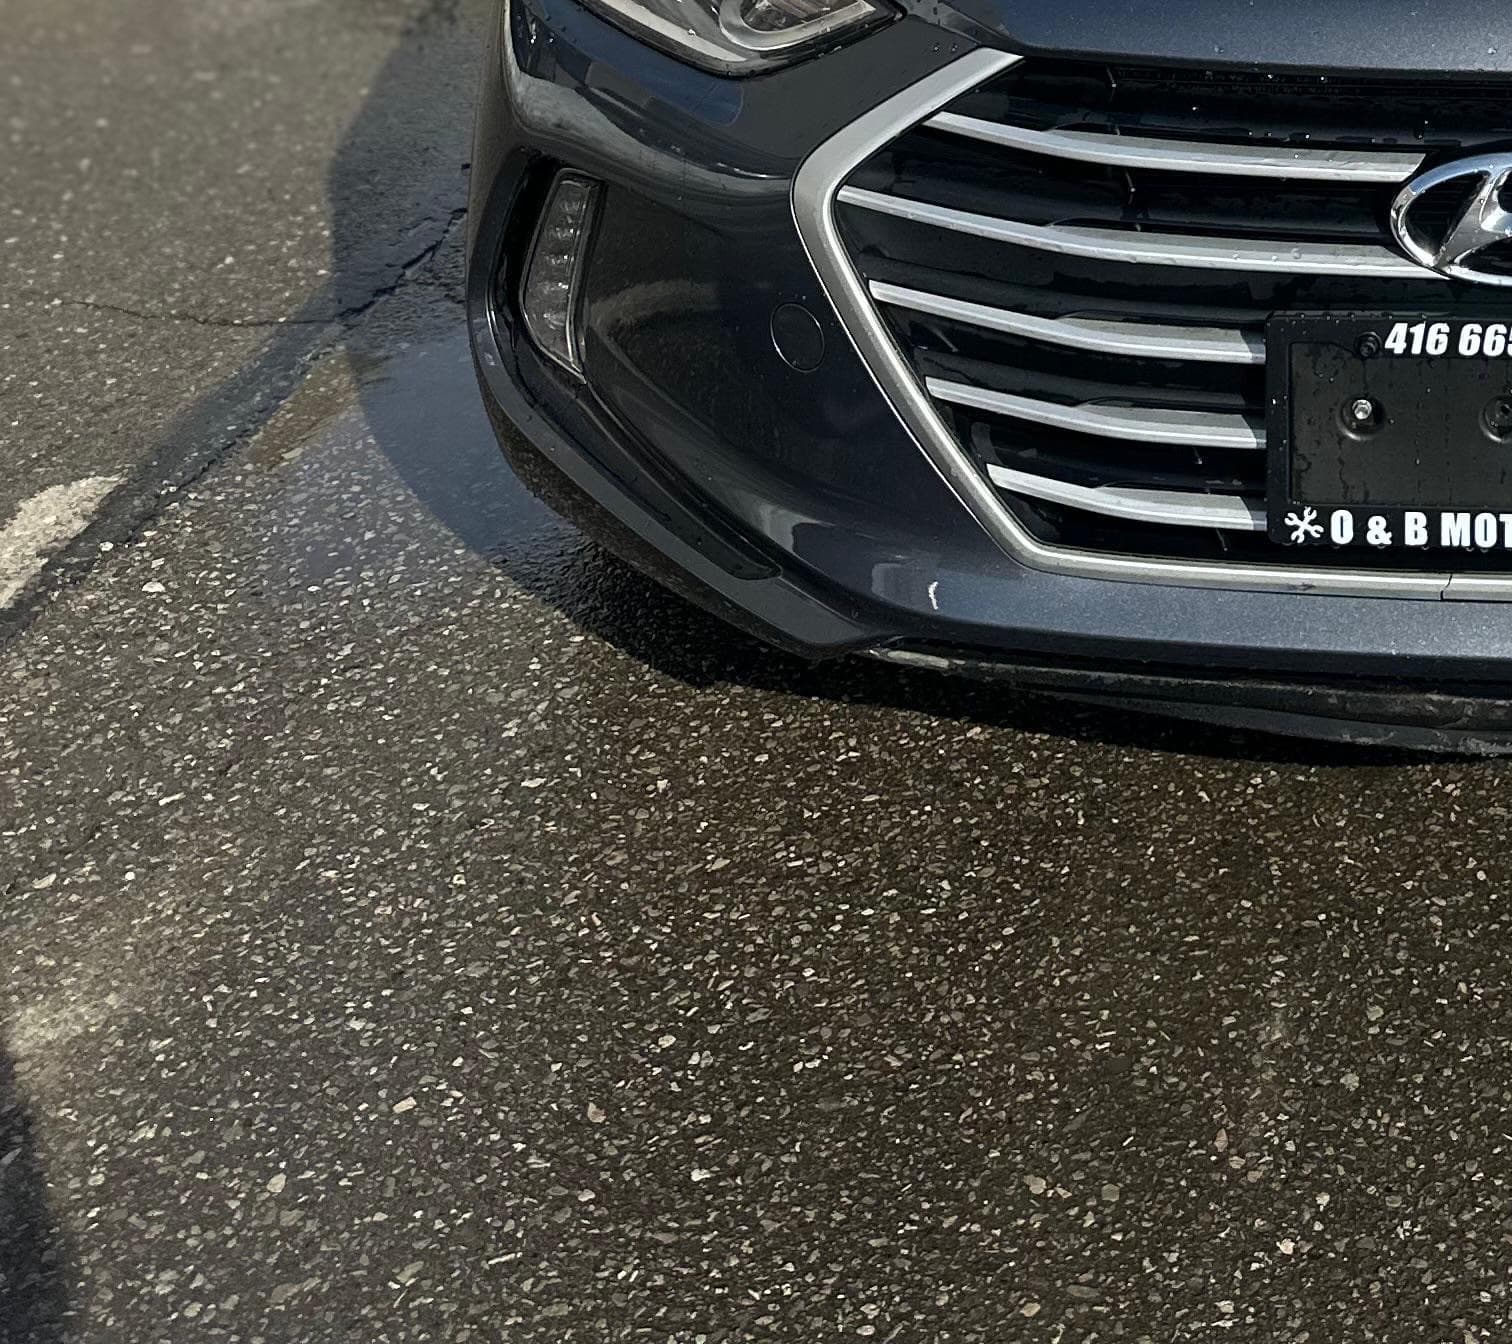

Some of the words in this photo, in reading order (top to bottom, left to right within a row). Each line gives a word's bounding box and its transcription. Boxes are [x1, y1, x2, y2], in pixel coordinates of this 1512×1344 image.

[1384, 322, 1450, 356] 416
[1330, 509, 1354, 545] O
[1366, 515, 1393, 546] &
[1404, 511, 1429, 546] B
